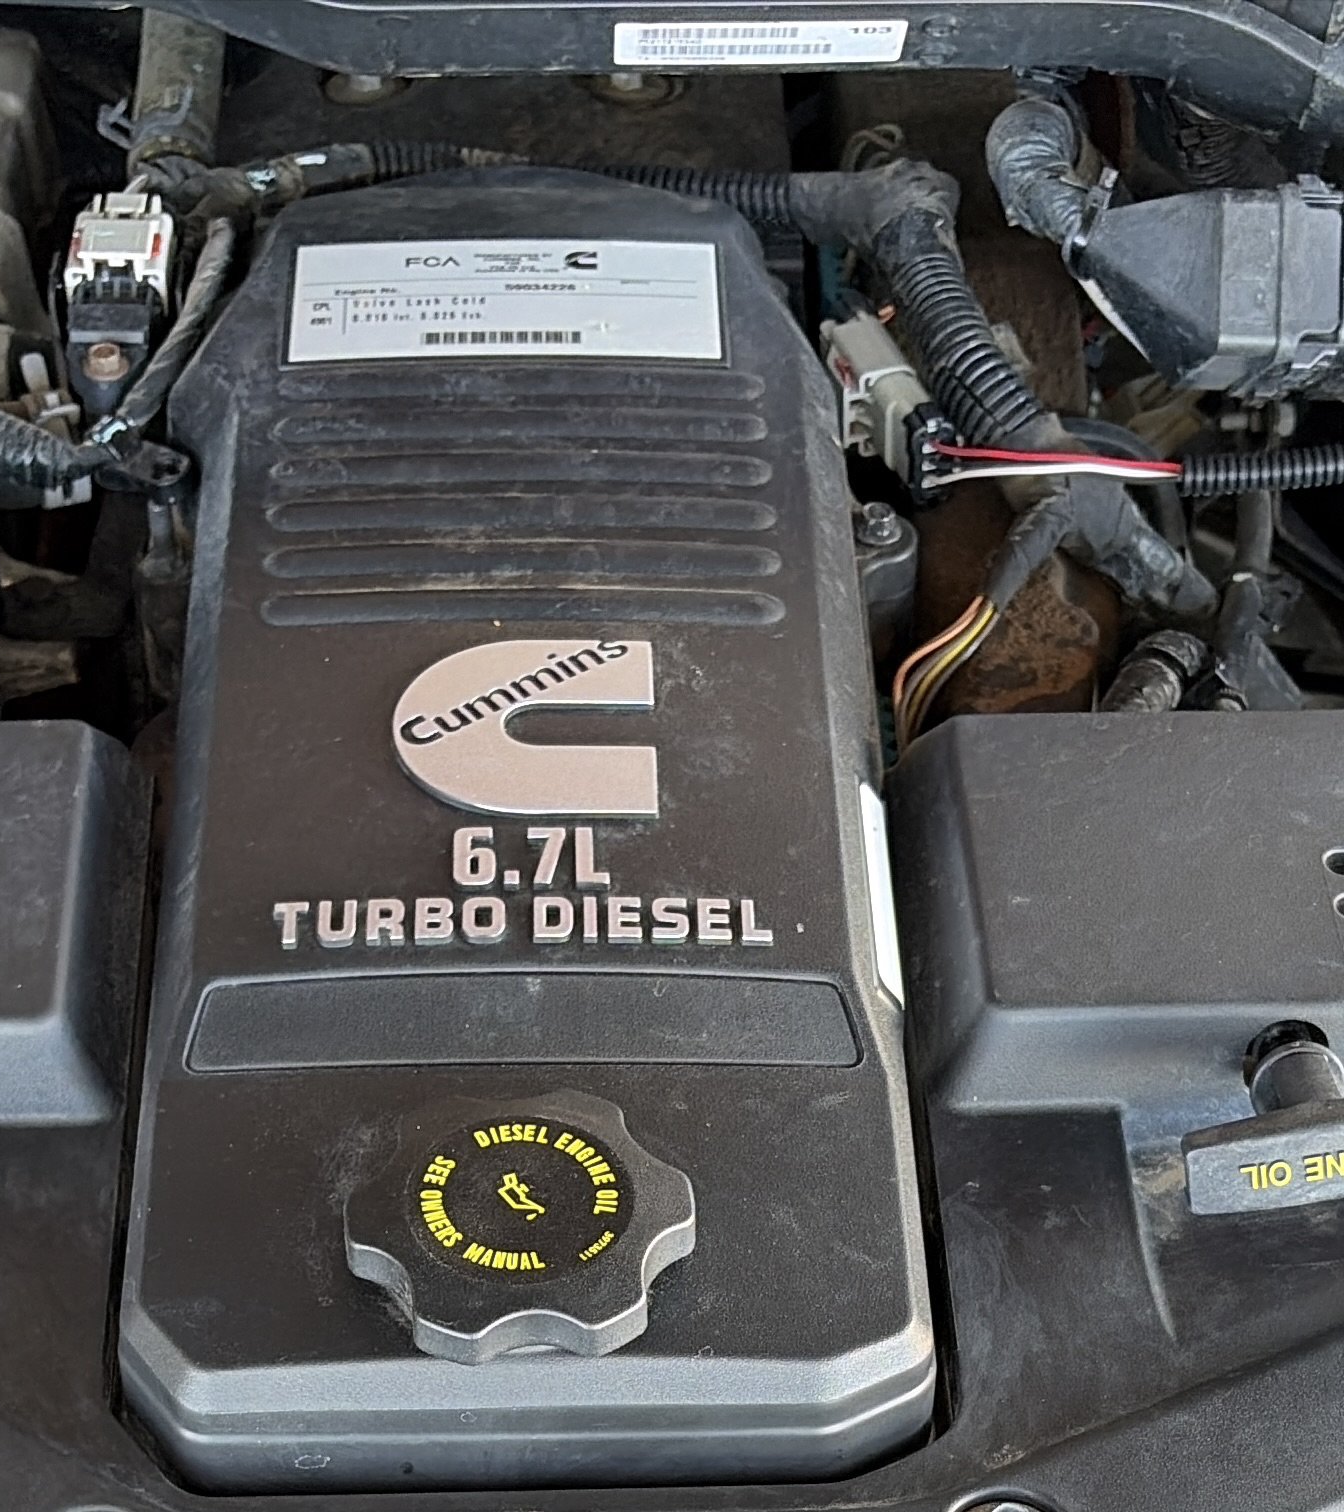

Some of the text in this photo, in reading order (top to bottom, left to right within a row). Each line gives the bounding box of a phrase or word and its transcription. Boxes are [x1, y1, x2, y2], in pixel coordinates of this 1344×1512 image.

[849, 26, 893, 34] 103
[405, 255, 461, 268] FCA
[398, 638, 630, 746] Cummins
[452, 826, 611, 890] 6.7L
[273, 896, 774, 950] TURBO DIESEL
[472, 1123, 619, 1215] DIESEL ENGINE OIL
[1239, 1159, 1293, 1190] OIL
[419, 1154, 546, 1271] SEE OWNERS MANUAL
